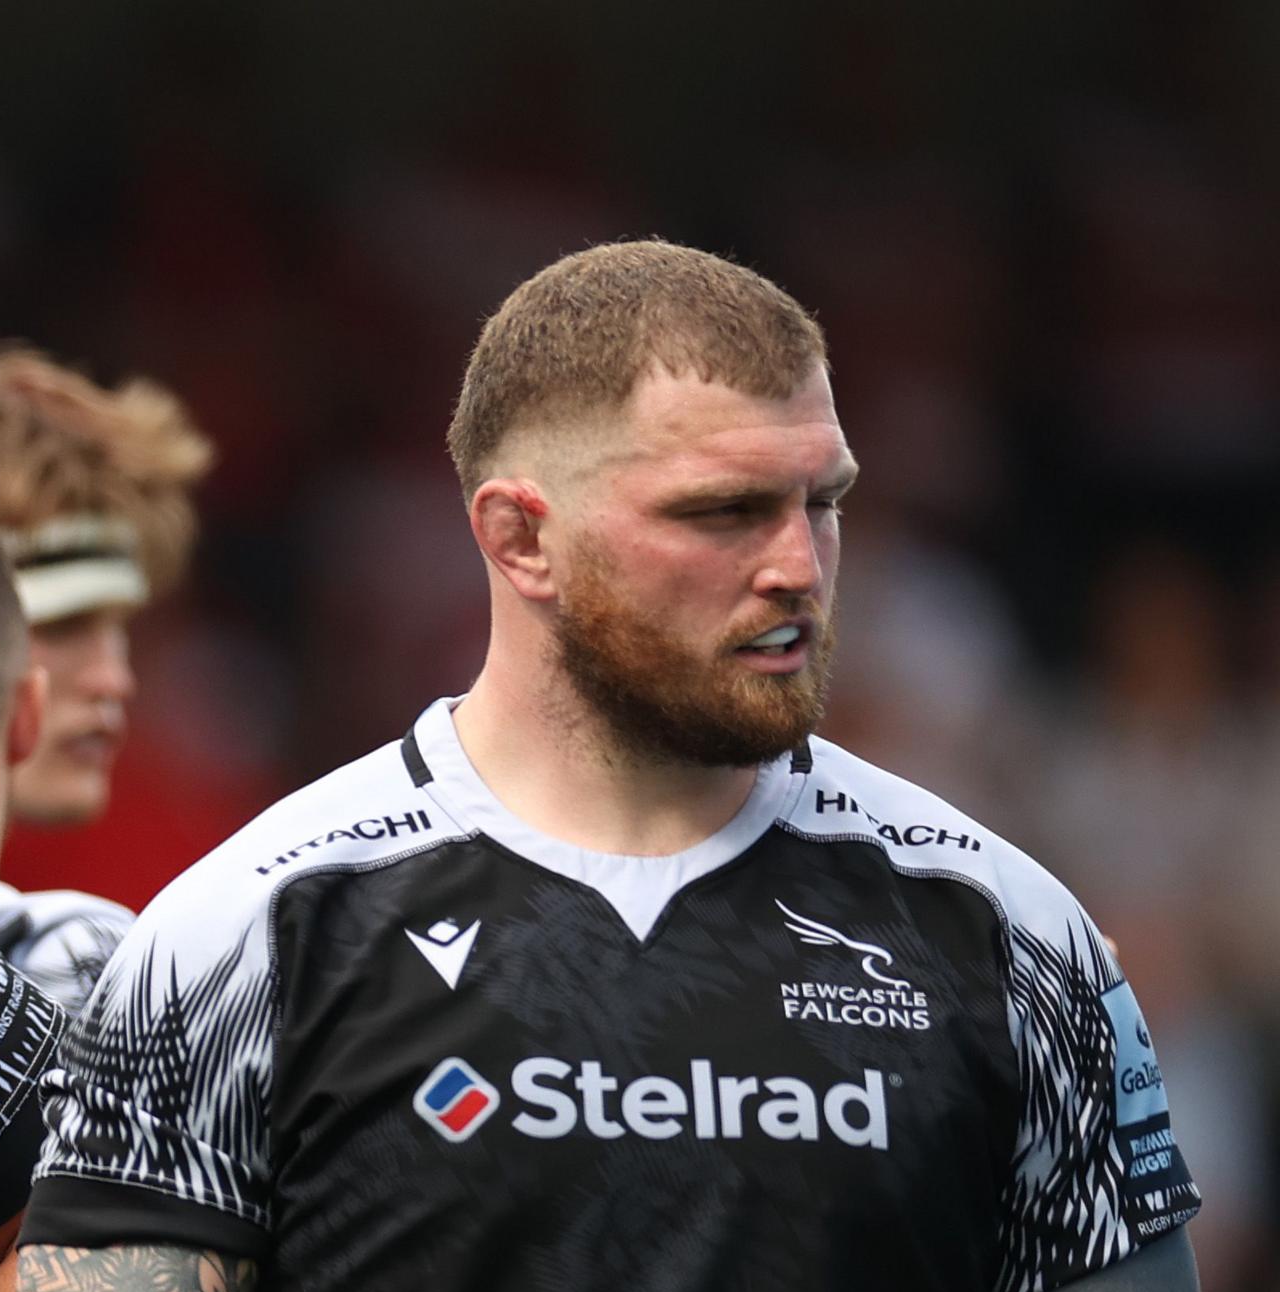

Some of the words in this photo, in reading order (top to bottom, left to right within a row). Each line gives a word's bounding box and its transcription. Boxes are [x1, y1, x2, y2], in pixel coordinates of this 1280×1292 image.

[255, 810, 432, 875] HITACHI
[780, 982, 928, 1007] NEWCASTLE
[783, 999, 930, 1030] FALCONS
[1137, 1215, 1171, 1237] RUGBY
